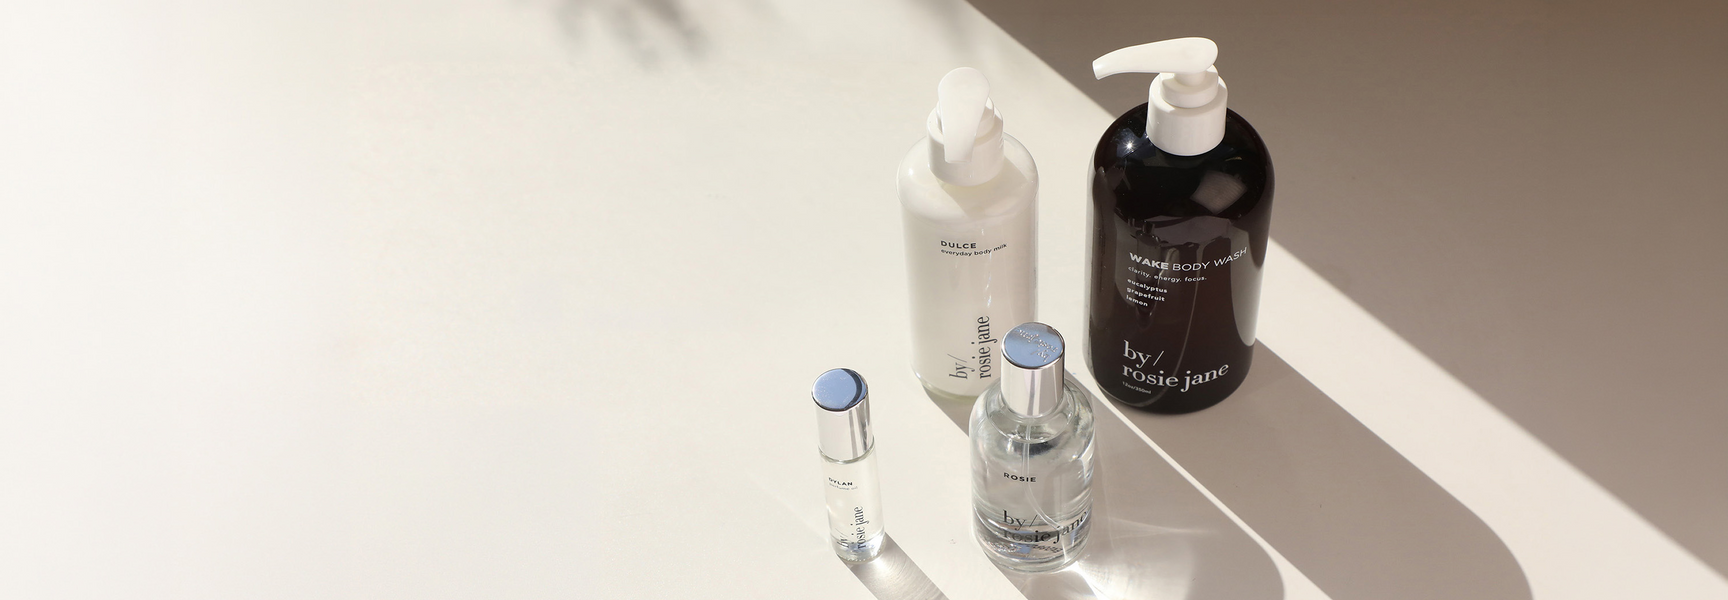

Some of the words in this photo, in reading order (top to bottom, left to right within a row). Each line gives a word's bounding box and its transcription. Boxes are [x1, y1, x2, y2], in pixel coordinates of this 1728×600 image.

[941, 240, 977, 249] DULCE
[941, 249, 973, 257] everyday
[974, 248, 992, 256] body
[993, 243, 1008, 252] milk
[1129, 252, 1169, 270] WAKE
[1172, 261, 1211, 271] BODY
[1213, 246, 1248, 267] WASH
[1127, 278, 1168, 293] eucalyptus
[1126, 286, 1165, 302] grapefruit
[1126, 294, 1148, 307] lemon
[971, 316, 998, 345] jane
[972, 346, 992, 379] rosie
[1122, 365, 1179, 387] rosie
[1180, 364, 1229, 392] jane
[1003, 472, 1037, 482] ROSIE
[1003, 529, 1051, 543] rosie
